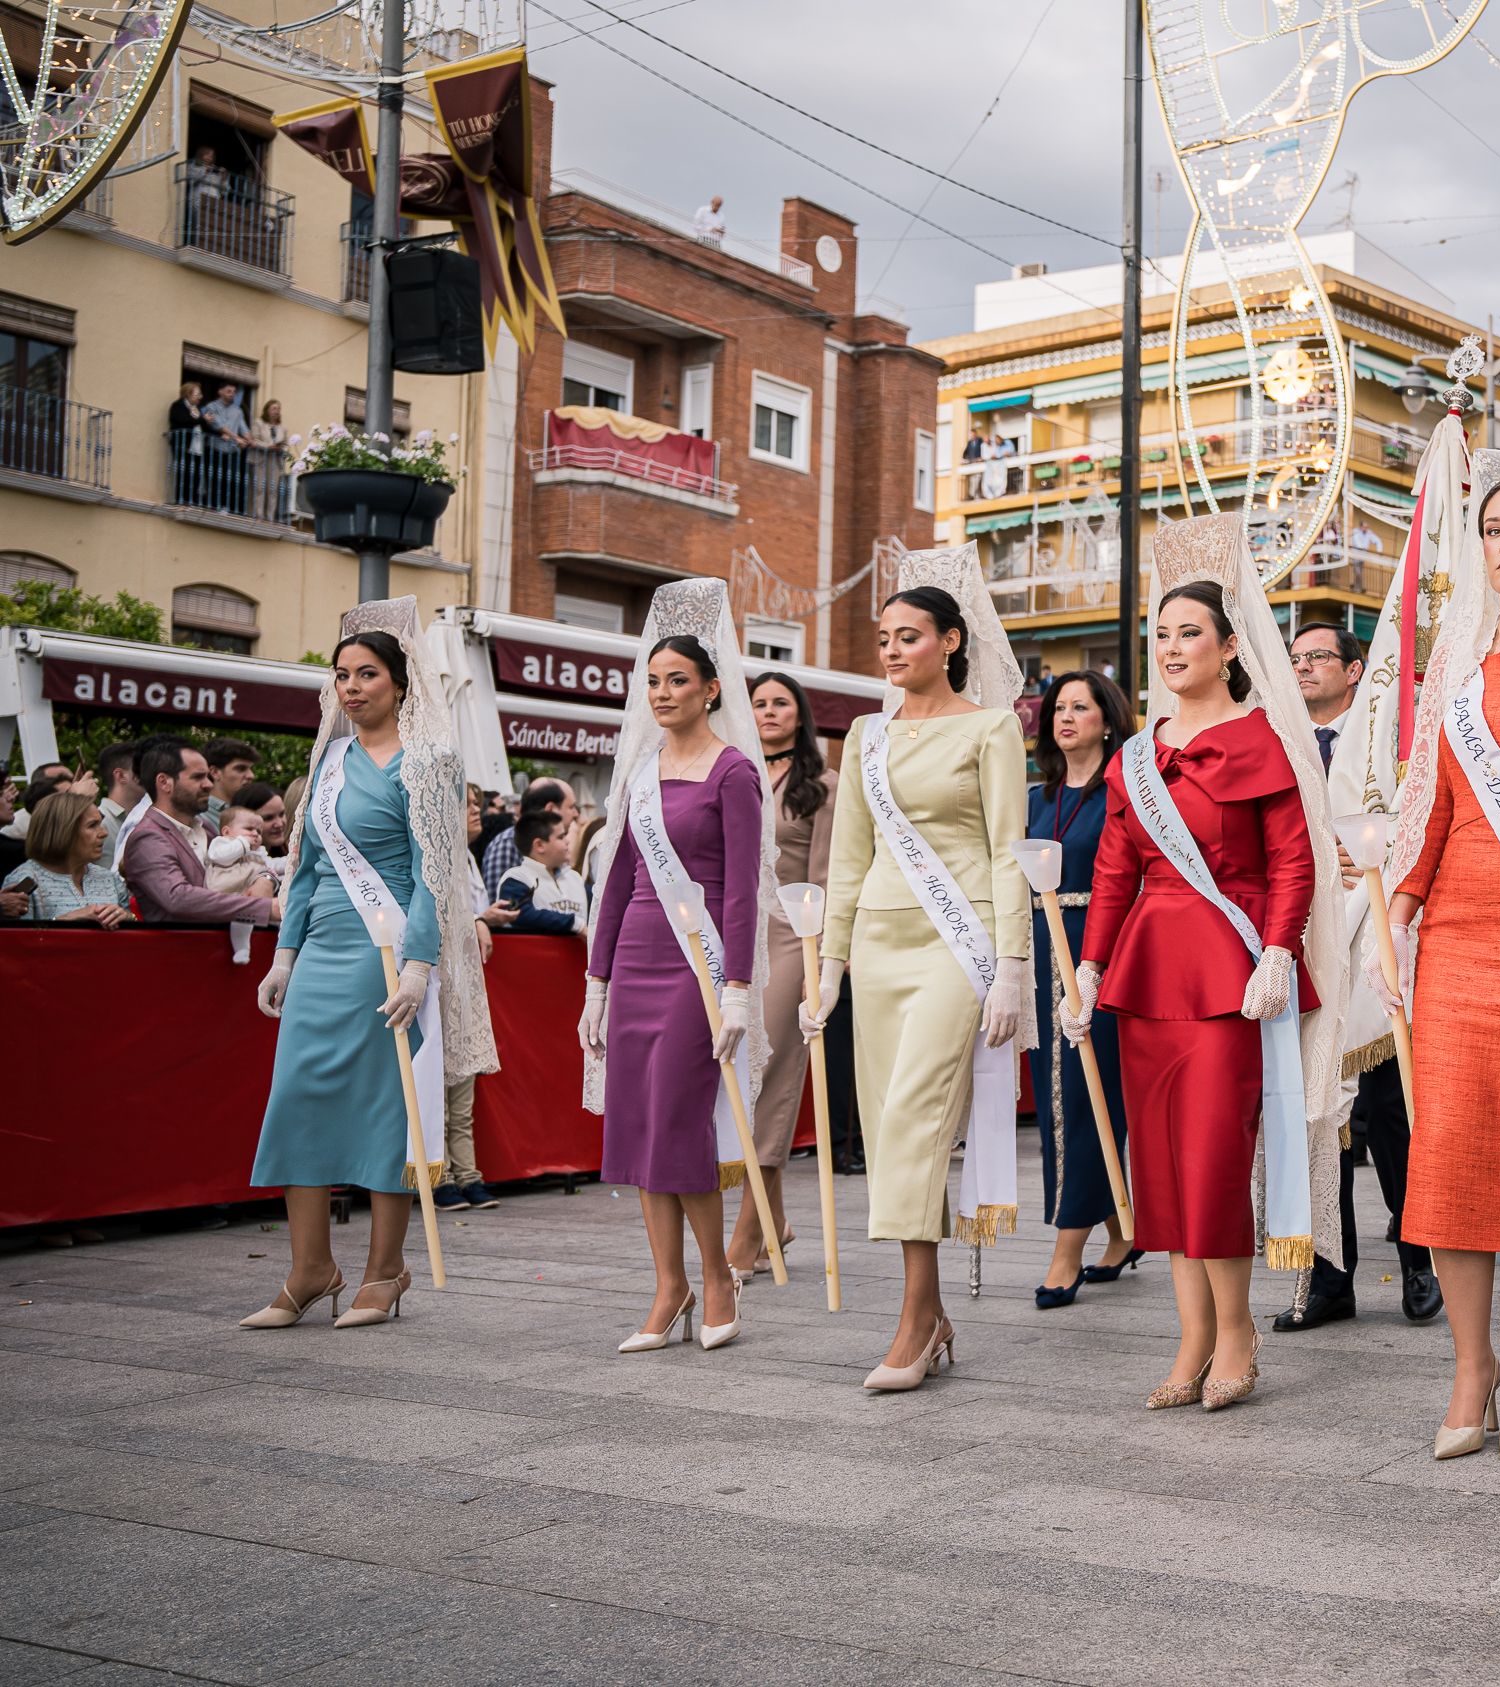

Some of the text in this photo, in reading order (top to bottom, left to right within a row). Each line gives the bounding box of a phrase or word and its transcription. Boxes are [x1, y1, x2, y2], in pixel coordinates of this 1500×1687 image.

[74, 672, 237, 716] alacant
[508, 720, 572, 752] Sánchez
[1454, 697, 1486, 763] DAMA
[319, 786, 332, 833] DAMA
[336, 843, 357, 867] DE
[639, 815, 669, 870] DAMA
[867, 763, 894, 821] DAMA
[900, 835, 924, 866] DE
[923, 875, 969, 937] HONOR
